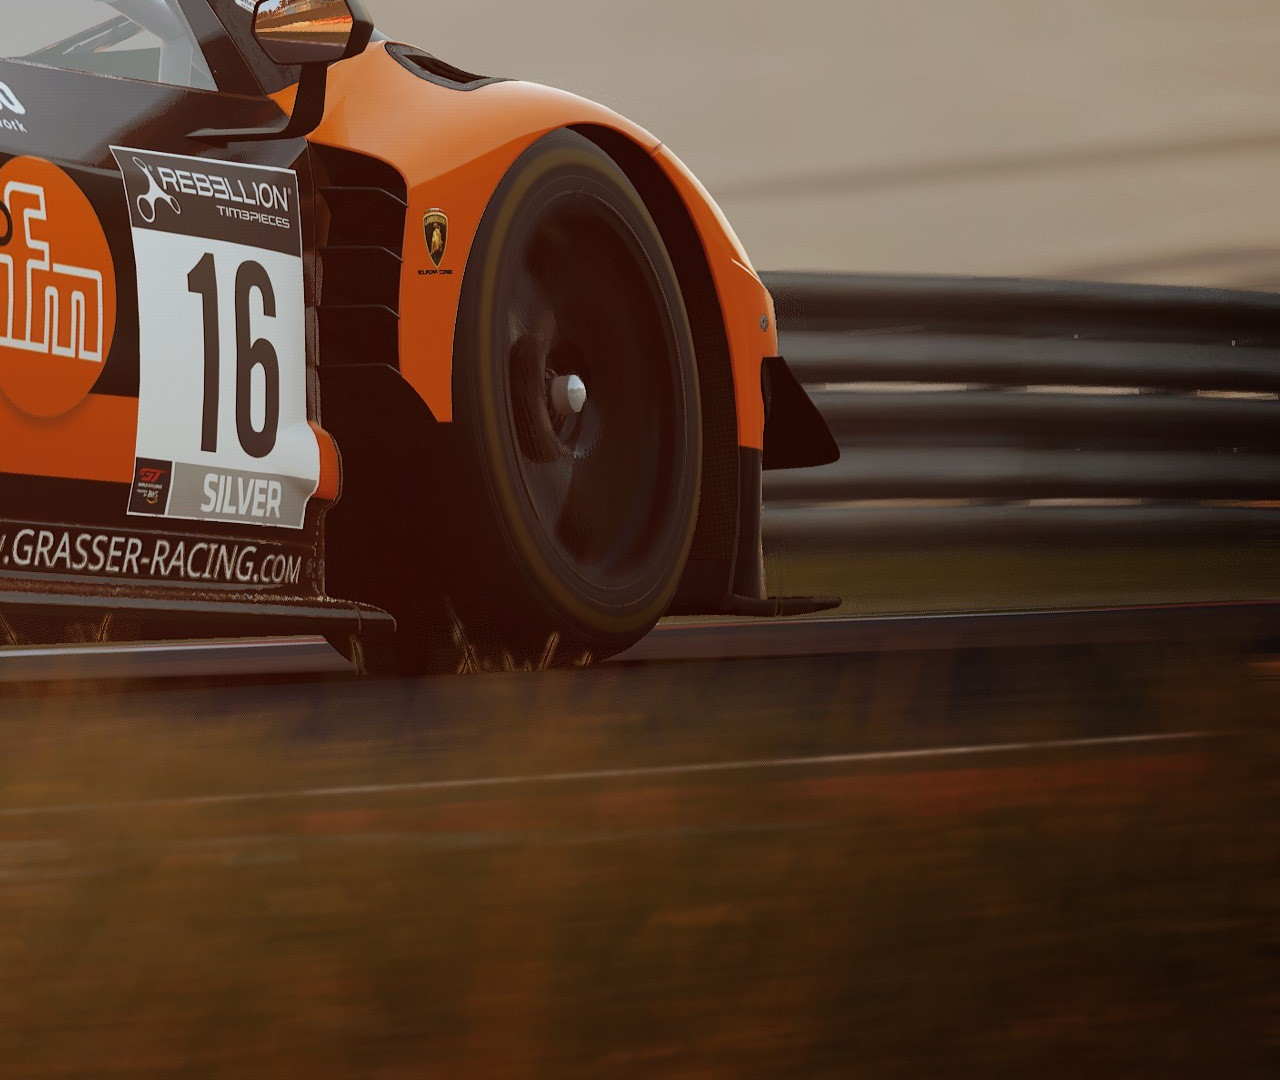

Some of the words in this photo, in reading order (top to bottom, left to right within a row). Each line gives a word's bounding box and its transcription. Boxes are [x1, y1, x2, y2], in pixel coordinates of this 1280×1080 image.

[156, 166, 289, 212] REBELLION
[187, 252, 280, 458] 16
[200, 472, 282, 519] SILVER
